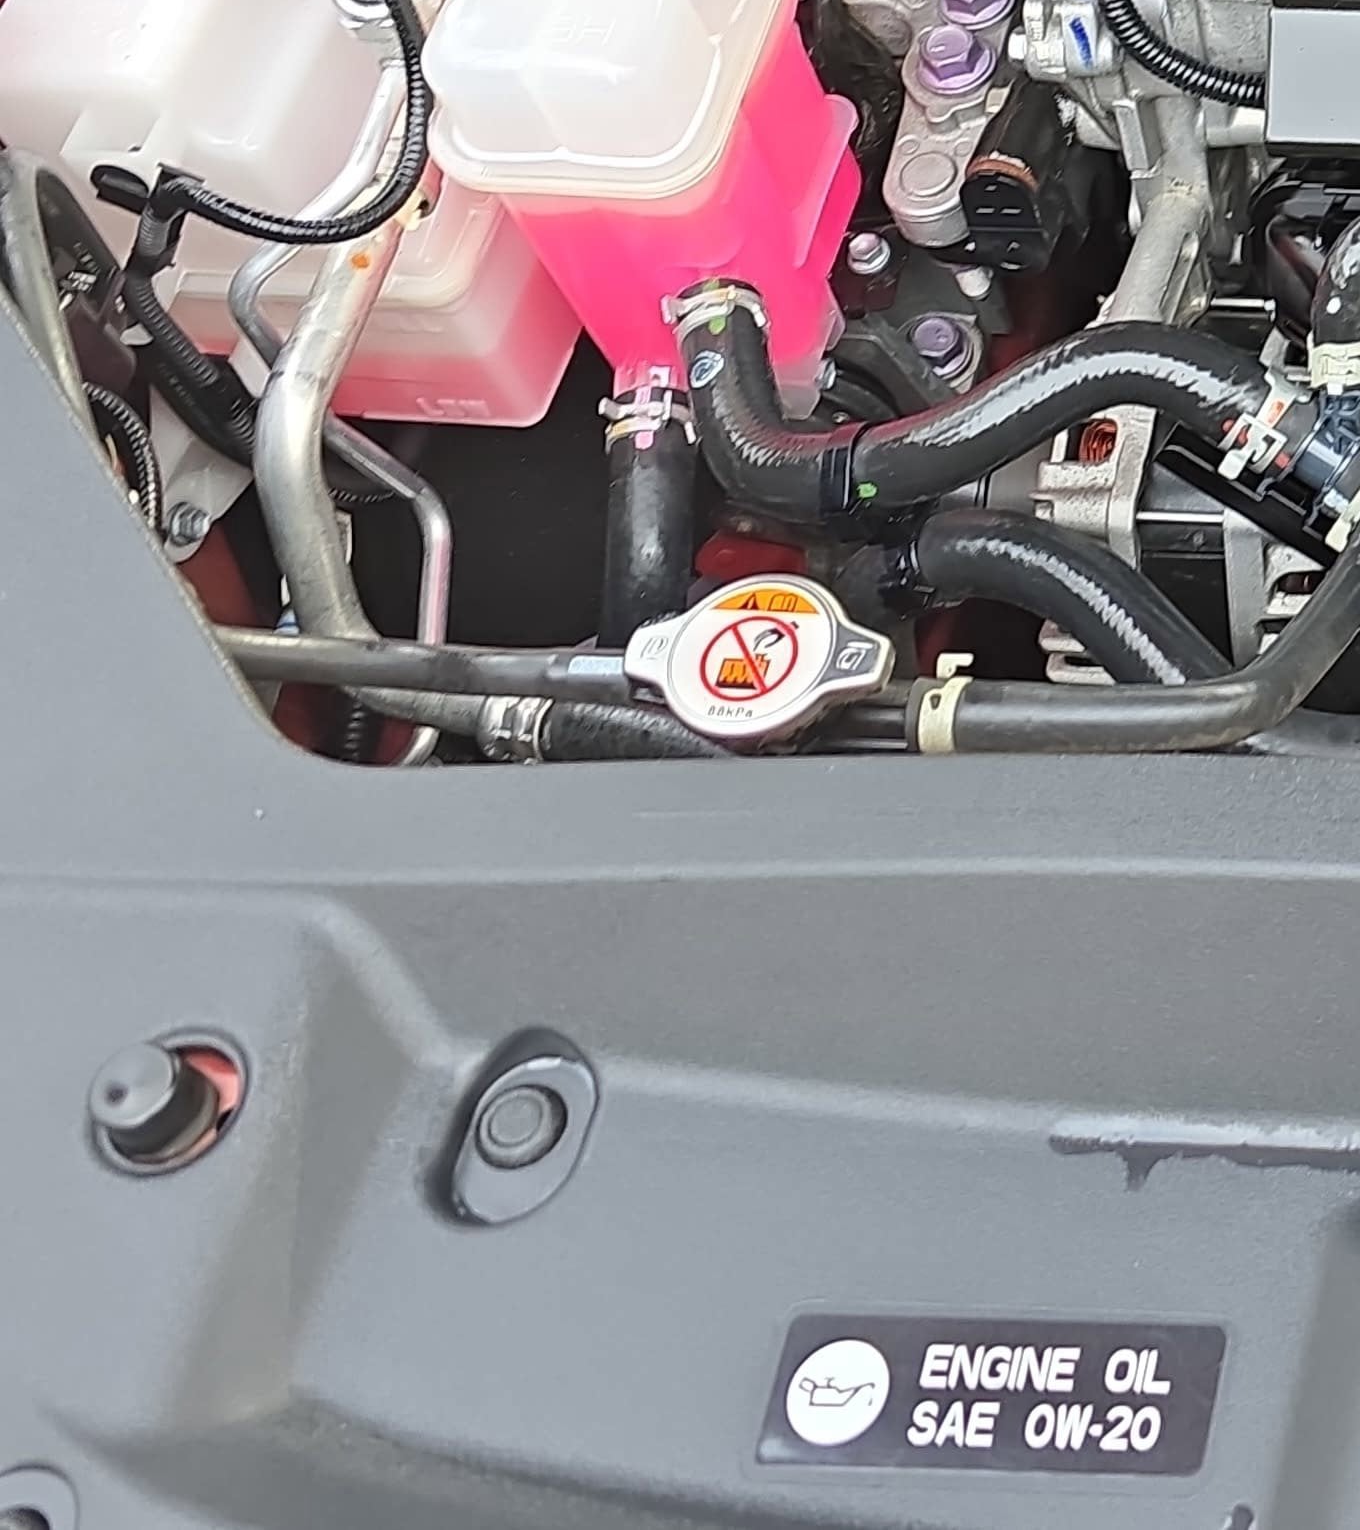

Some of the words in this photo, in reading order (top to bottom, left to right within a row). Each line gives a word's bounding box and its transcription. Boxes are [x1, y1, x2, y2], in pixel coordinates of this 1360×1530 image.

[918, 1343, 1081, 1393] ENGINE
[1104, 1348, 1171, 1395] OIL
[907, 1400, 1000, 1448] SAE
[1024, 1403, 1162, 1451] 0W-20
